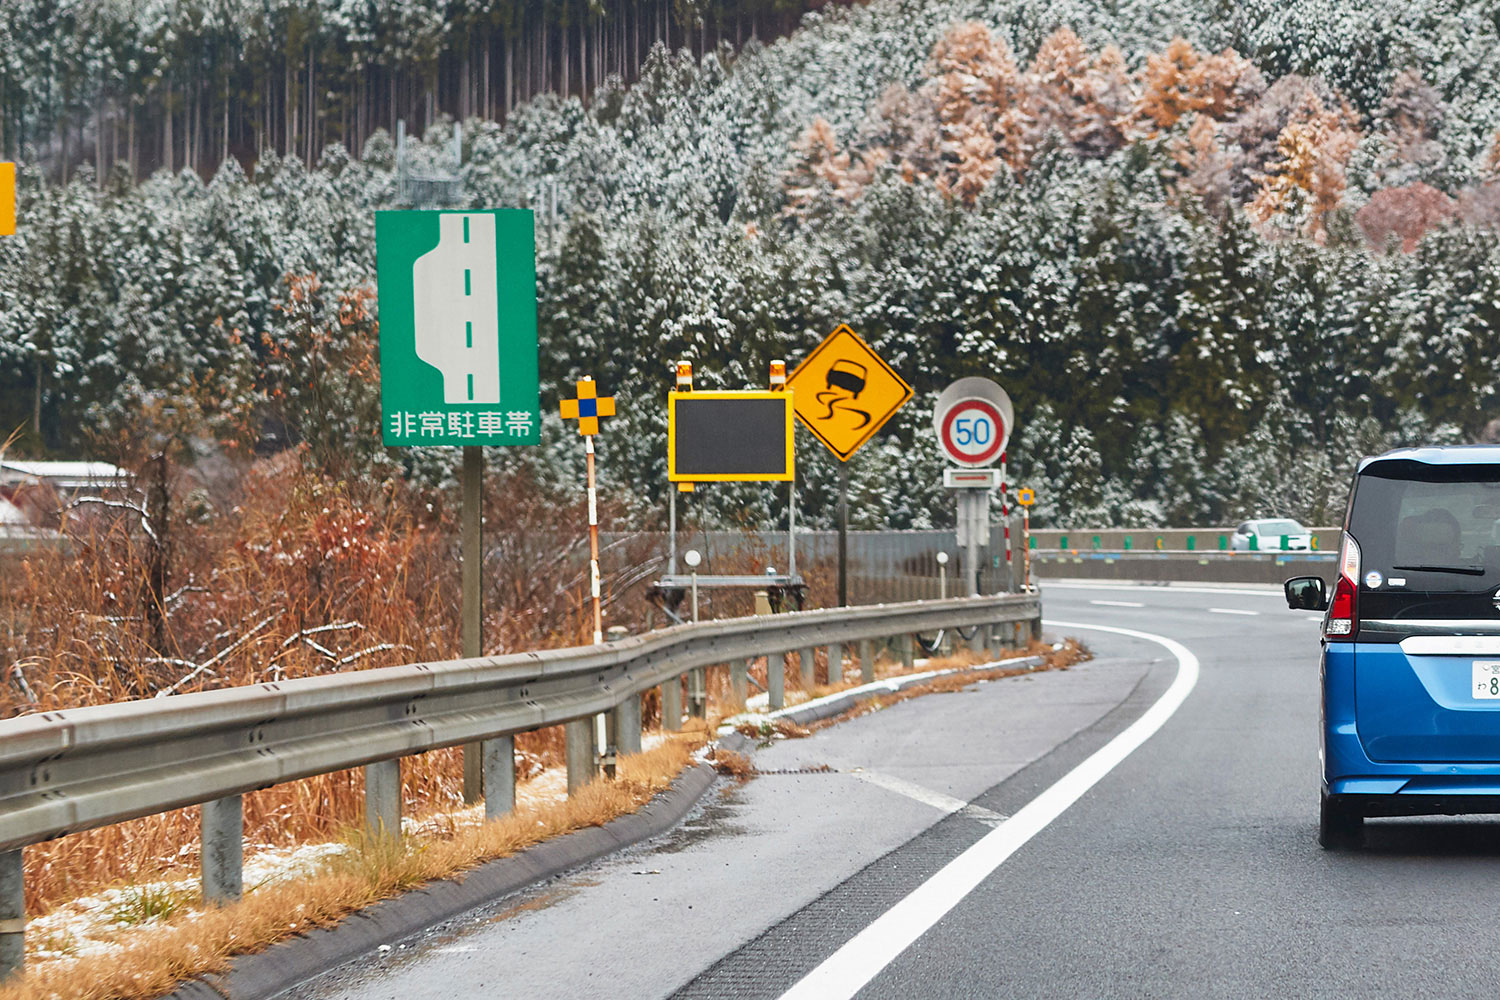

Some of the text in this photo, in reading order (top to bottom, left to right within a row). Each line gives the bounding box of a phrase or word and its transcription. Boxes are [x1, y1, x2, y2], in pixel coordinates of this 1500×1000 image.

[390, 411, 533, 438] 非常駐車帯
[956, 418, 989, 445] 50
